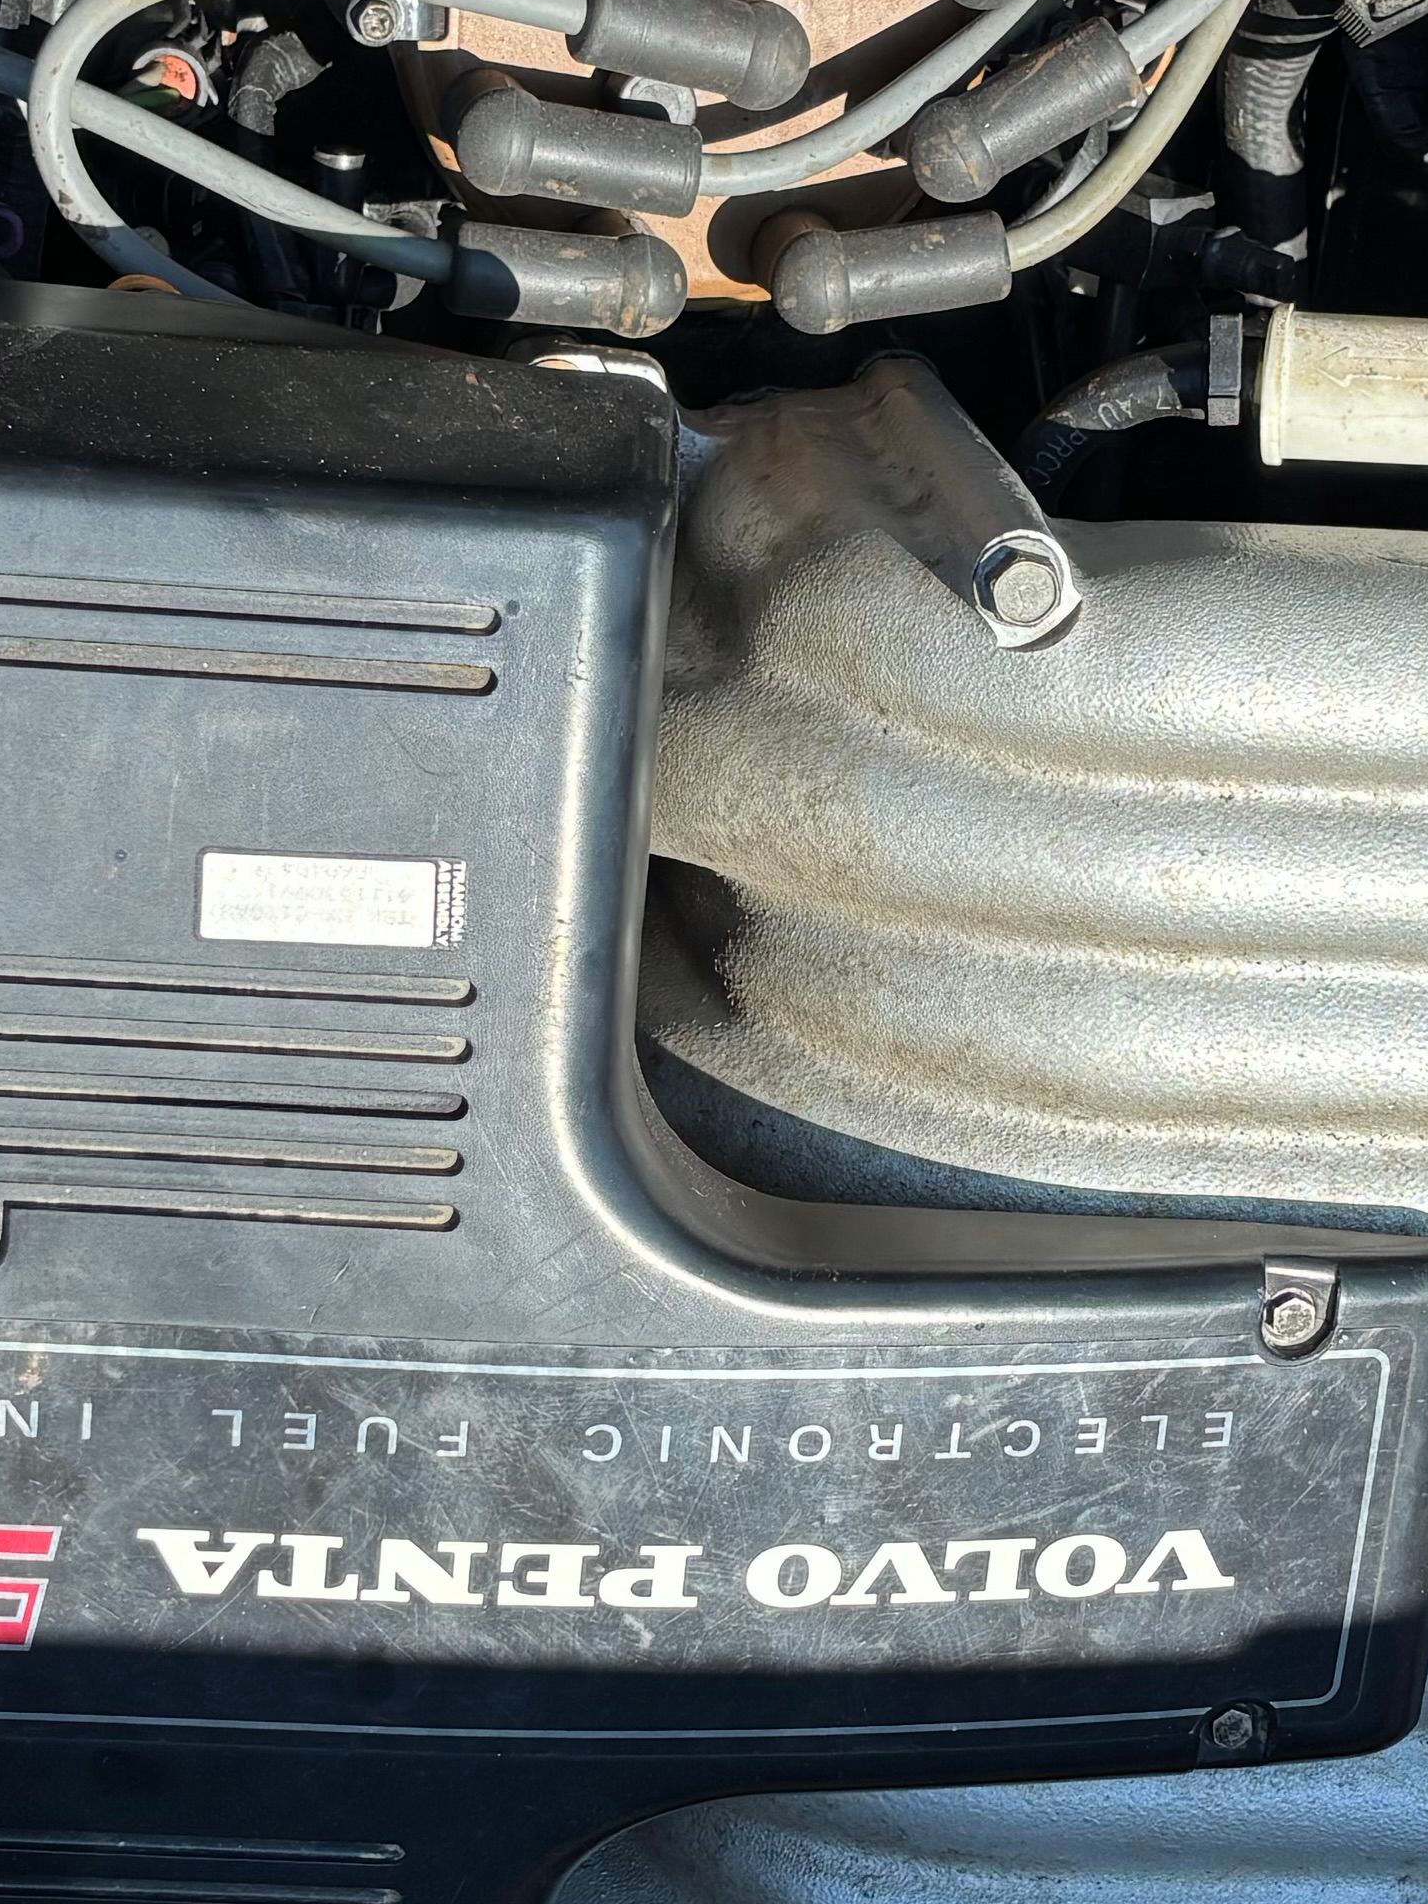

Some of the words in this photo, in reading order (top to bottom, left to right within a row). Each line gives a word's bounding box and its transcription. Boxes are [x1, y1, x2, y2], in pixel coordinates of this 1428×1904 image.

[211, 1405, 470, 1459] FUEL
[581, 1407, 1234, 1466] ELECTRONIC
[136, 1526, 702, 1612] PENTA
[744, 1526, 1236, 1610] VOLVO
